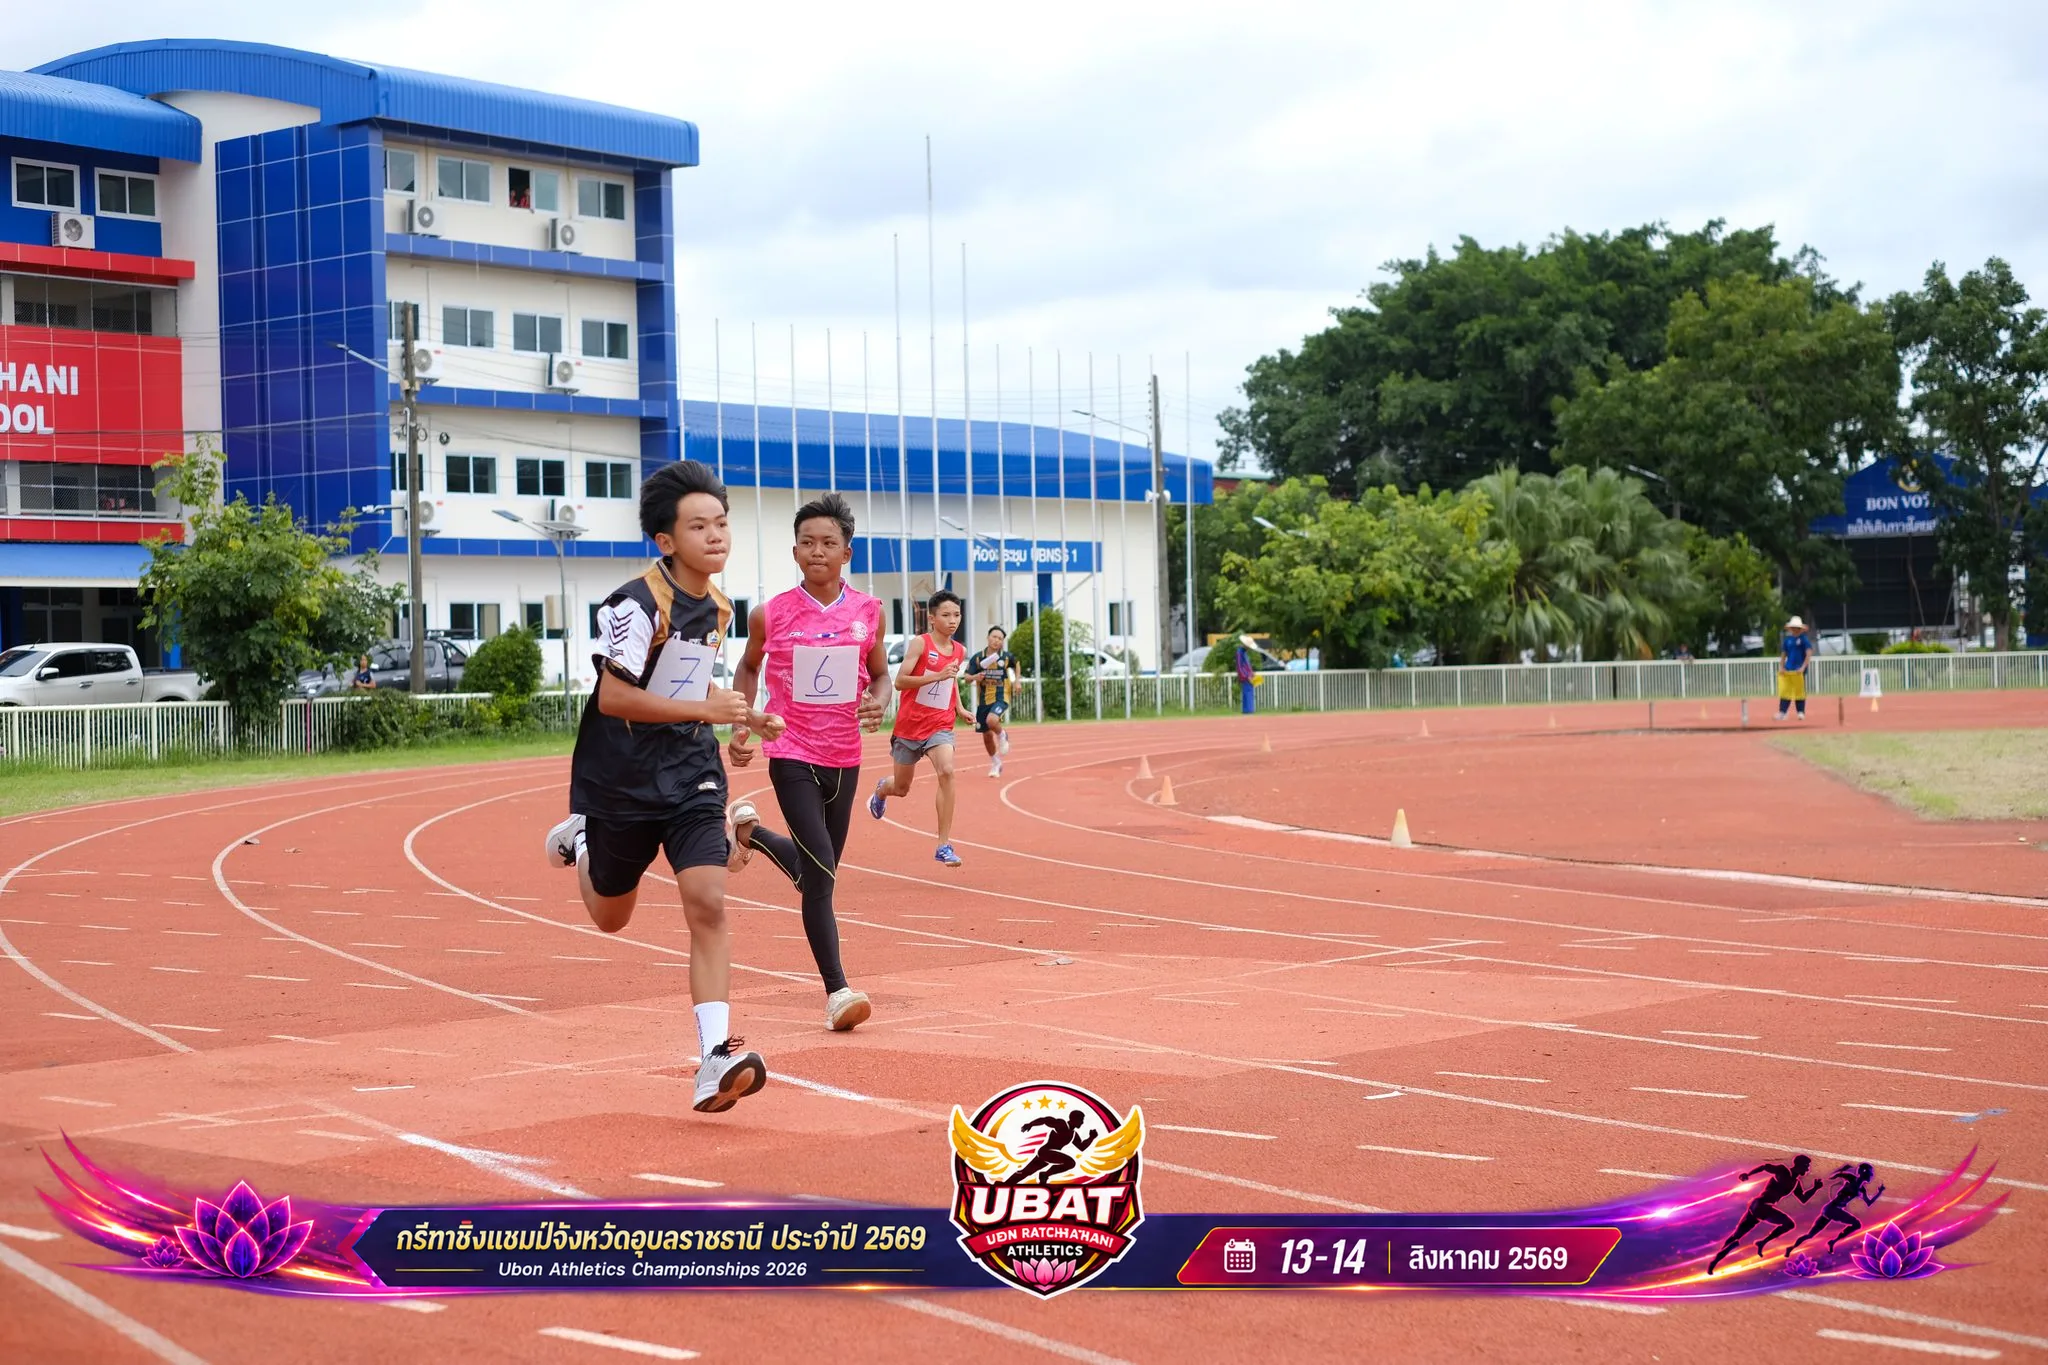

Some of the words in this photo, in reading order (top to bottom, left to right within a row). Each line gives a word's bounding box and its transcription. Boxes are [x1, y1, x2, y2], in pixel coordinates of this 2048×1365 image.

[1071, 549, 1078, 563] 1
[669, 657, 701, 698] 7
[814, 655, 834, 694] 6
[927, 681, 941, 701] 4
